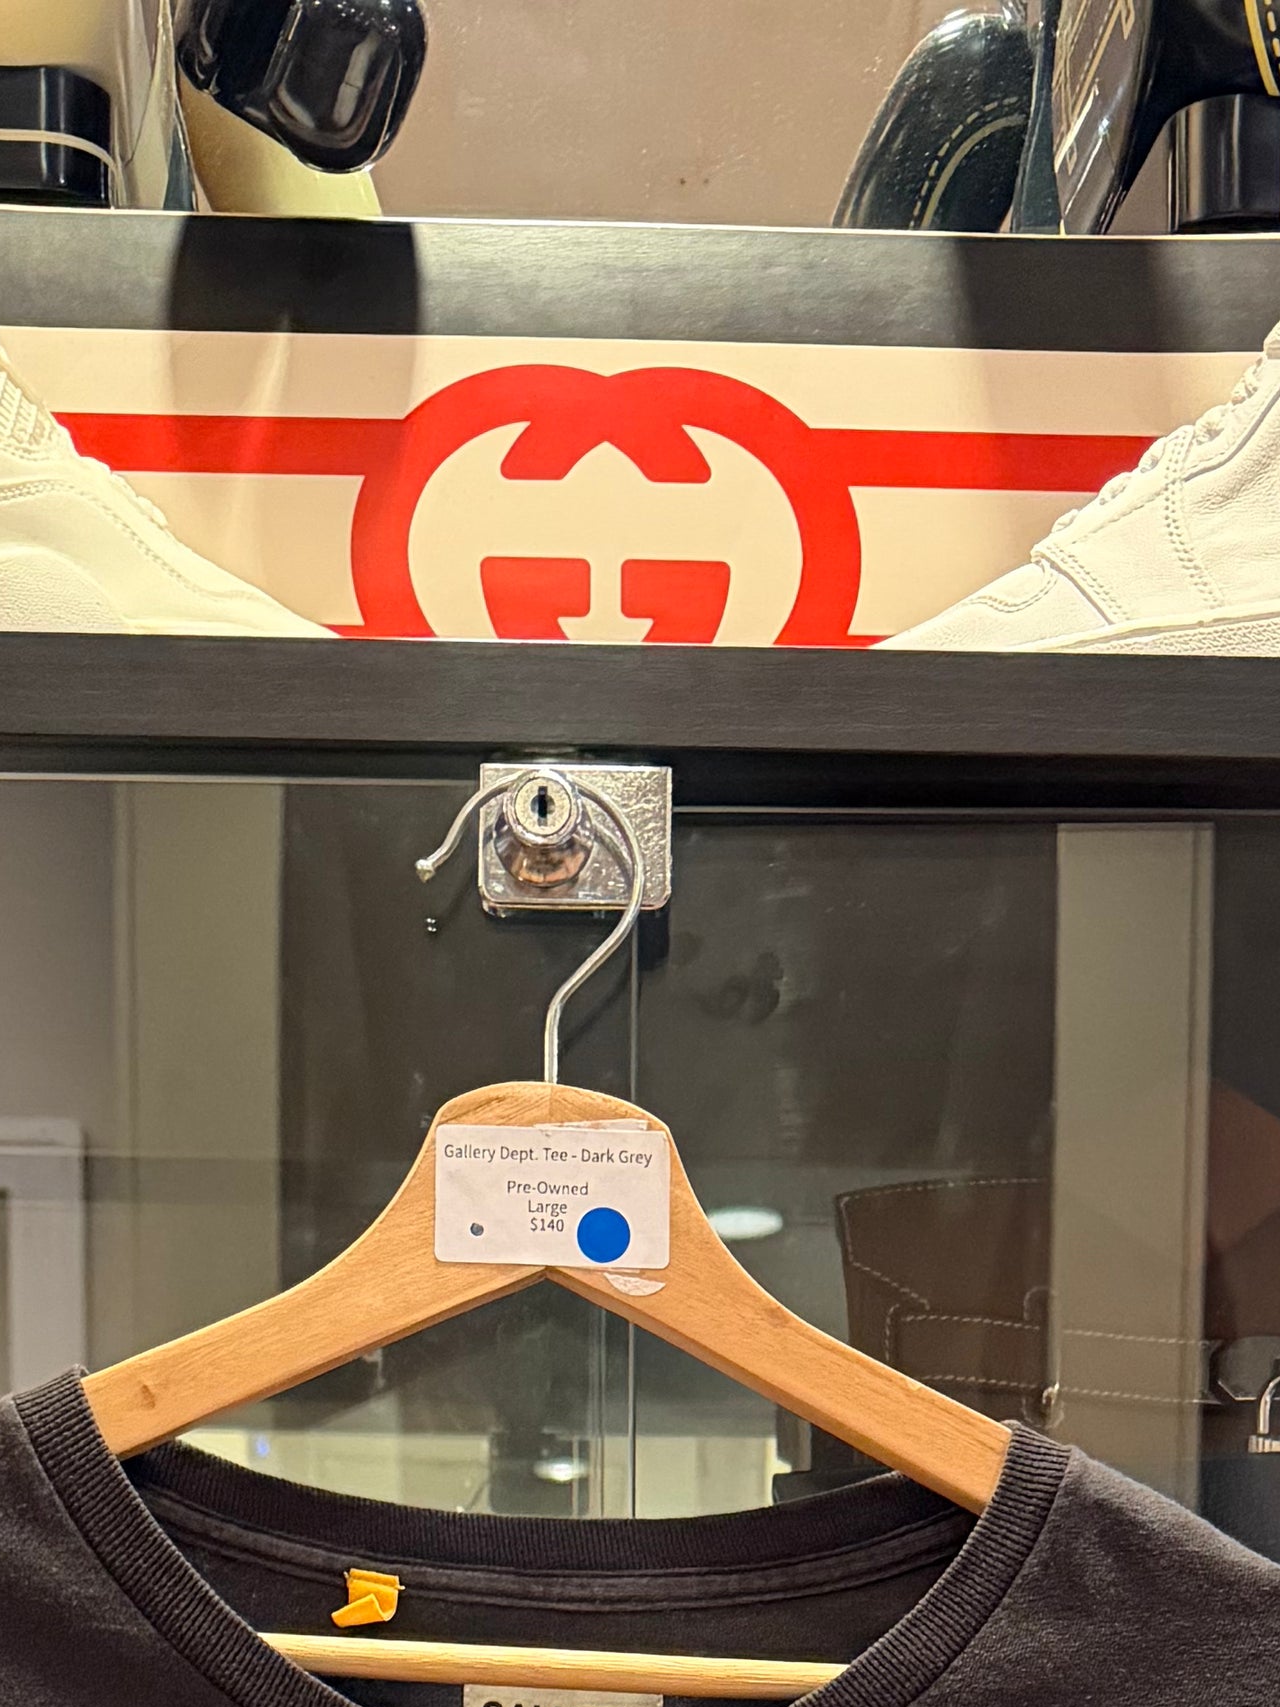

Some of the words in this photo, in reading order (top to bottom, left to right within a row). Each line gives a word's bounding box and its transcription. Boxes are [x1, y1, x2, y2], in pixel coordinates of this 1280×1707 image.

[444, 1144, 496, 1163] Gallery
[500, 1146, 538, 1163] Dept.
[543, 1147, 568, 1161] Tee
[581, 1148, 614, 1163] Dark
[618, 1150, 652, 1168] Grey
[507, 1180, 589, 1195] Pre-Owned
[528, 1199, 567, 1217] Large
[530, 1217, 564, 1232] $140
